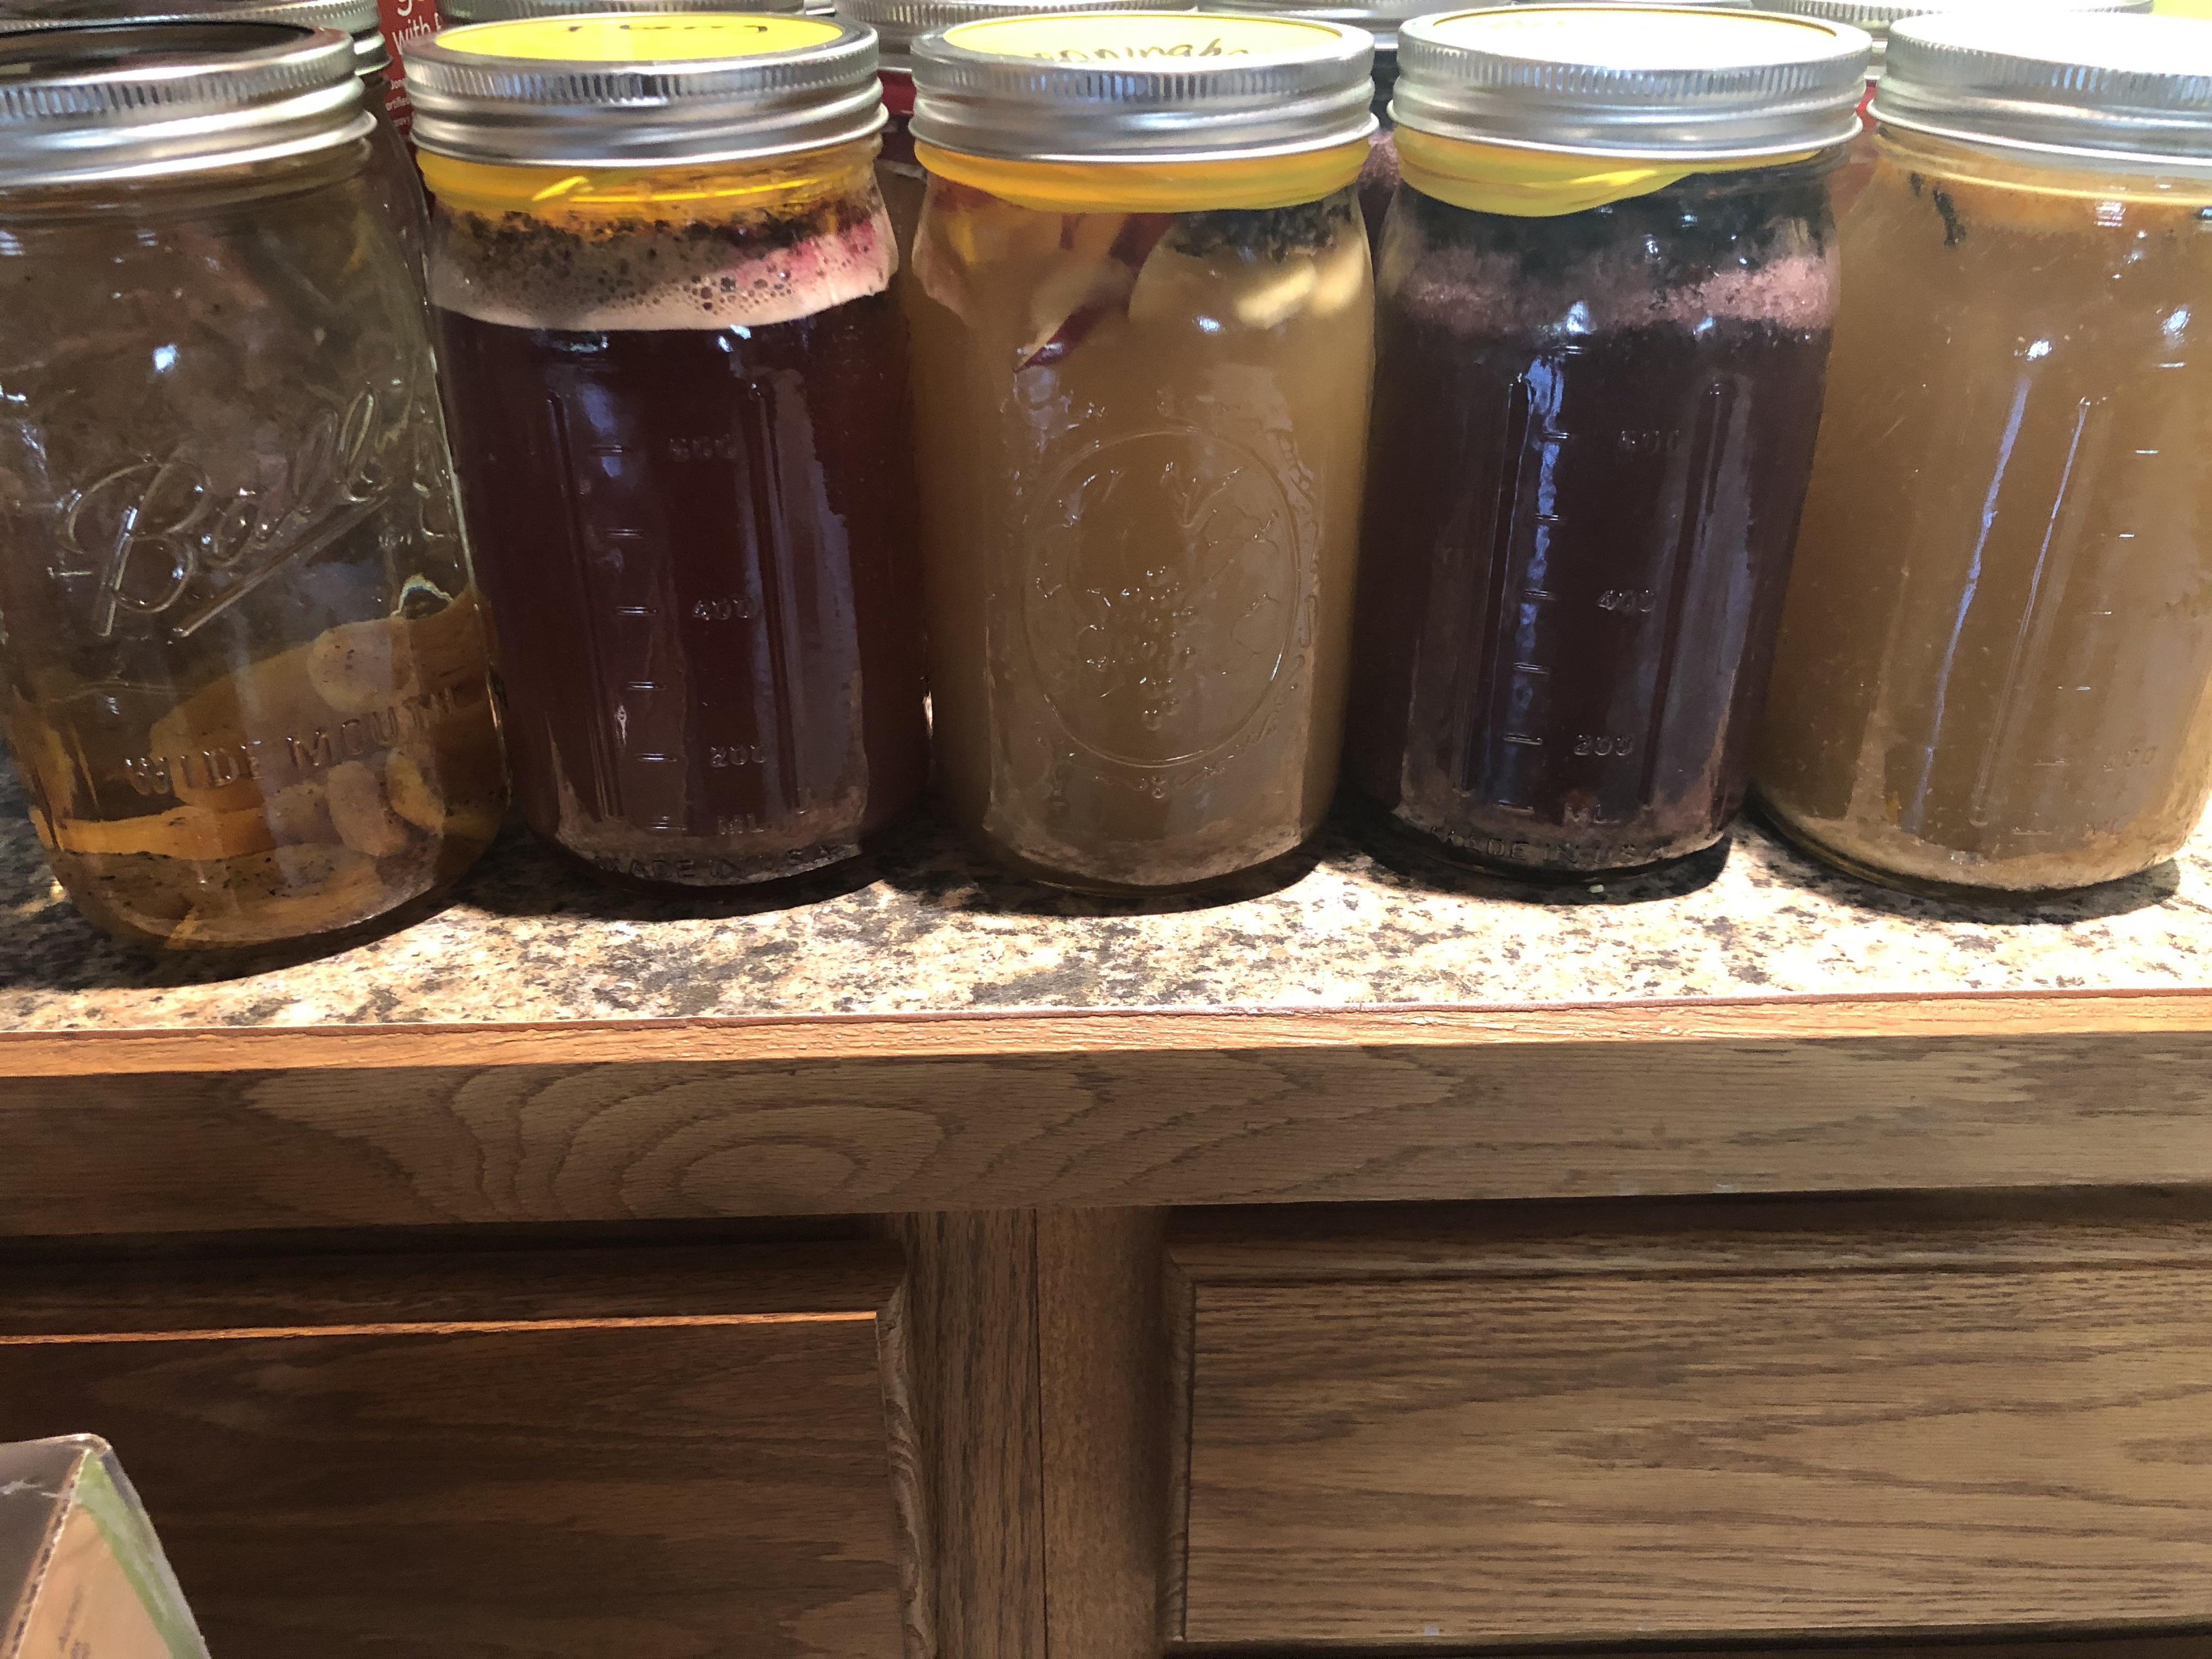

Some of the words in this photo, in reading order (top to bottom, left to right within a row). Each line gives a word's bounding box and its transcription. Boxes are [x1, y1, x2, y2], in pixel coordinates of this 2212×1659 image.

[1598, 589, 1657, 613] 400
[710, 744, 769, 768] 200
[1573, 733, 1633, 757] 200
[124, 738, 266, 796] WIDE
[1564, 802, 1620, 824] ML
